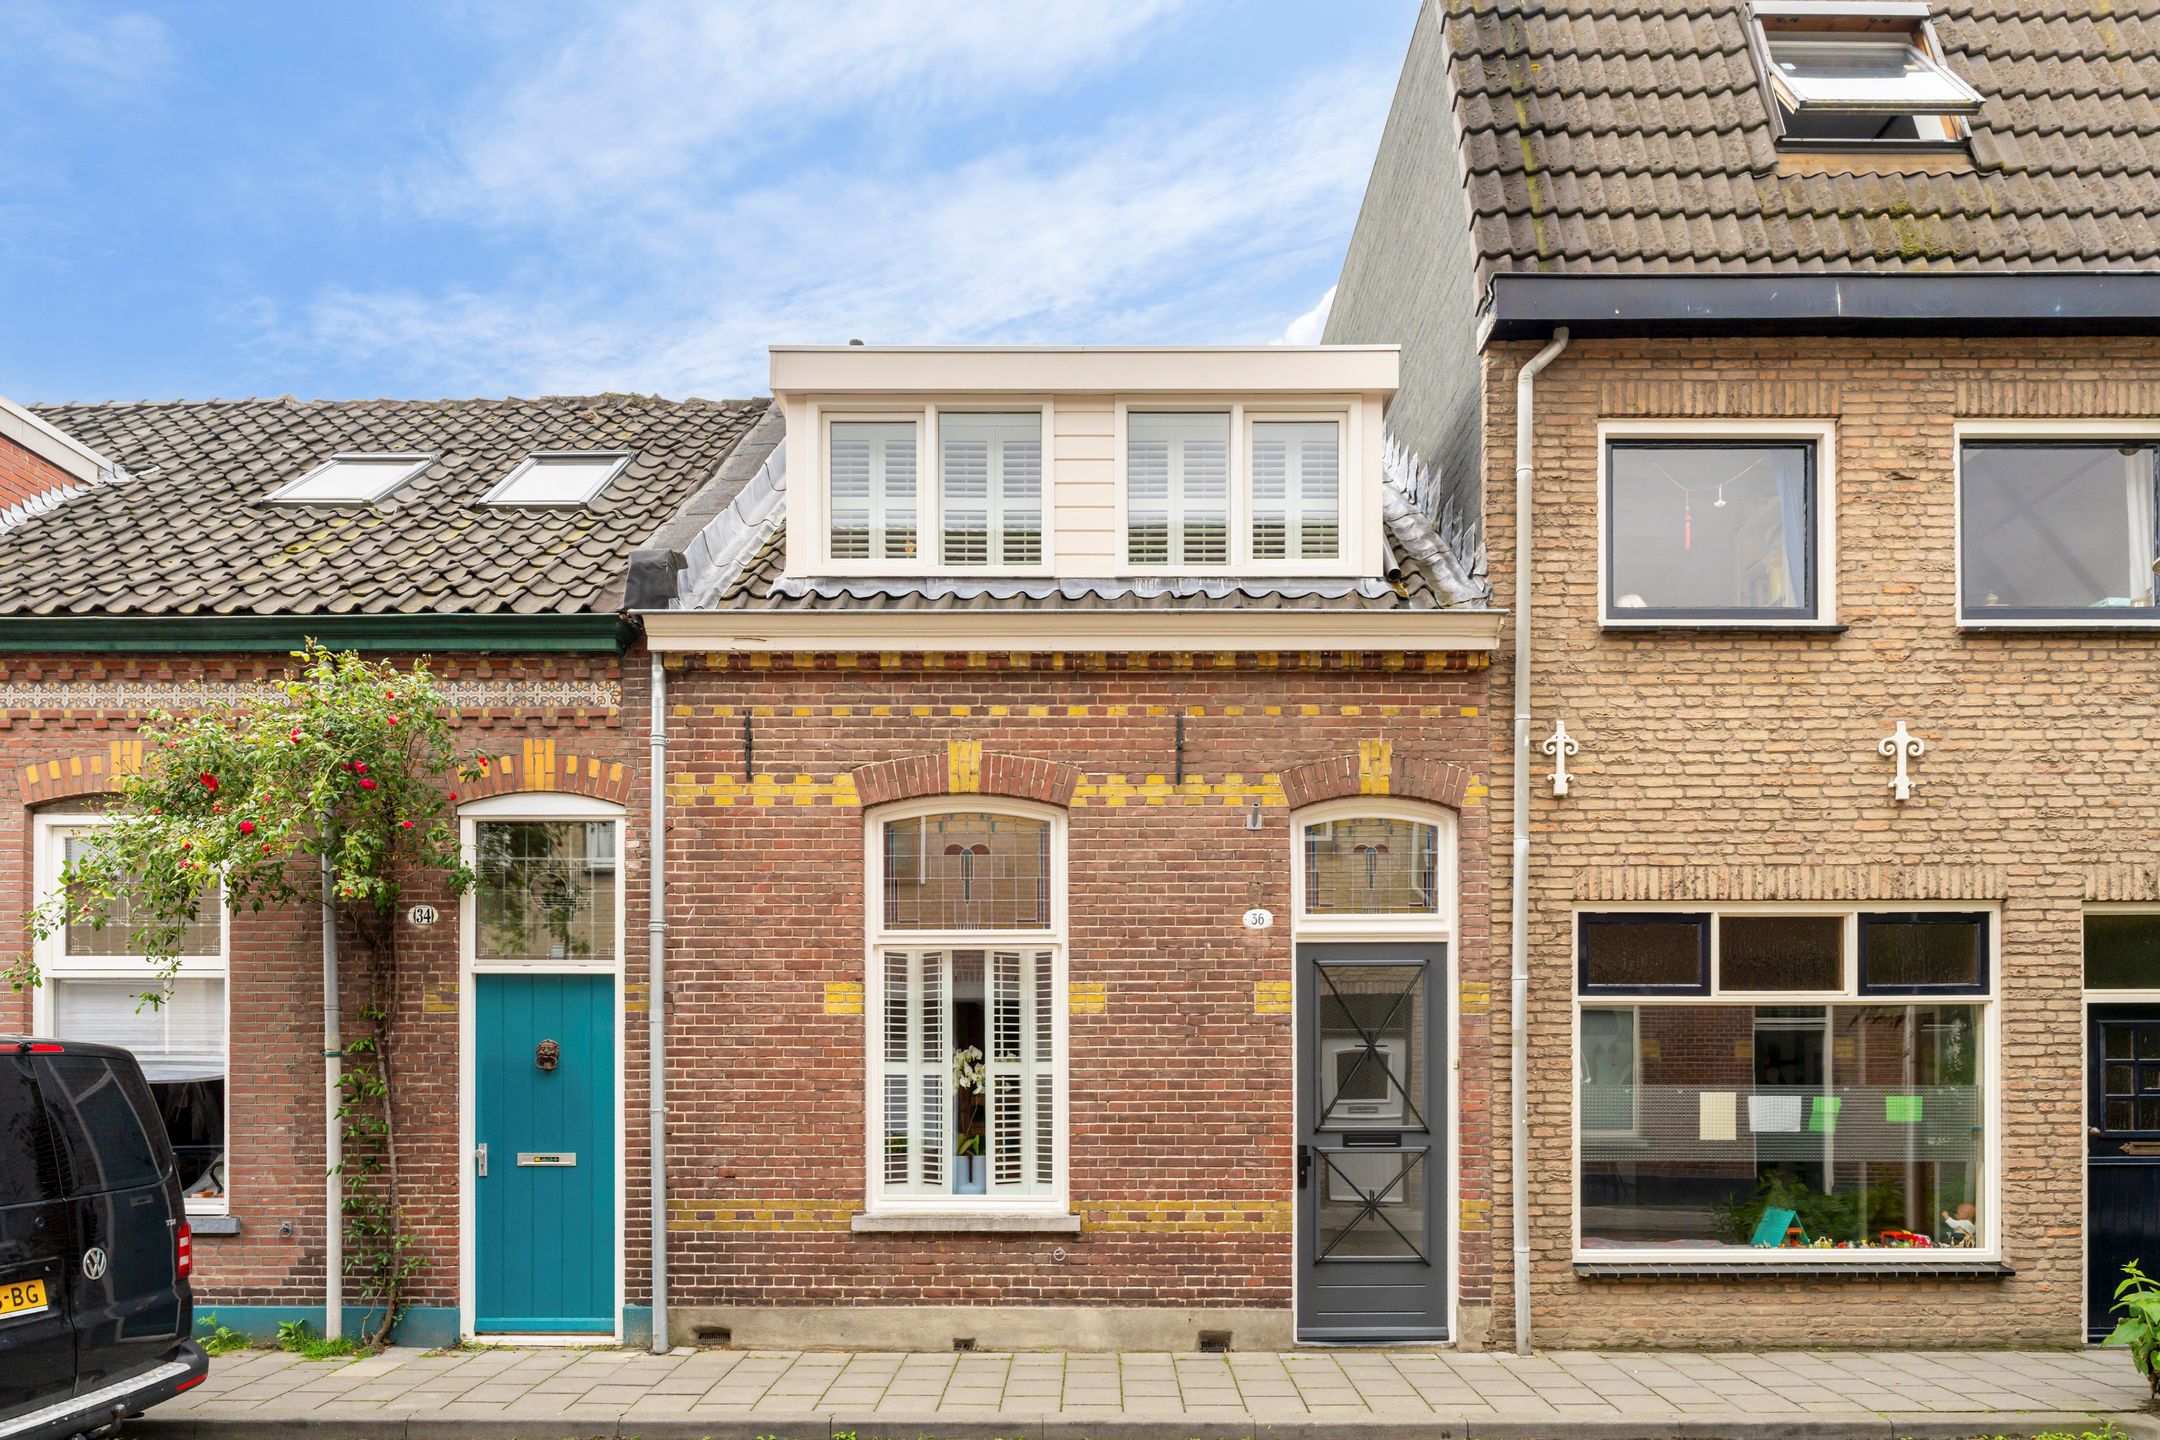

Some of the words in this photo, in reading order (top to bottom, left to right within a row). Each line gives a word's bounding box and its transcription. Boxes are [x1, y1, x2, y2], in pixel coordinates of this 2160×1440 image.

[416, 908, 431, 923] 34
[1251, 913, 1264, 926] 36
[0, 1285, 39, 1309] -BG
